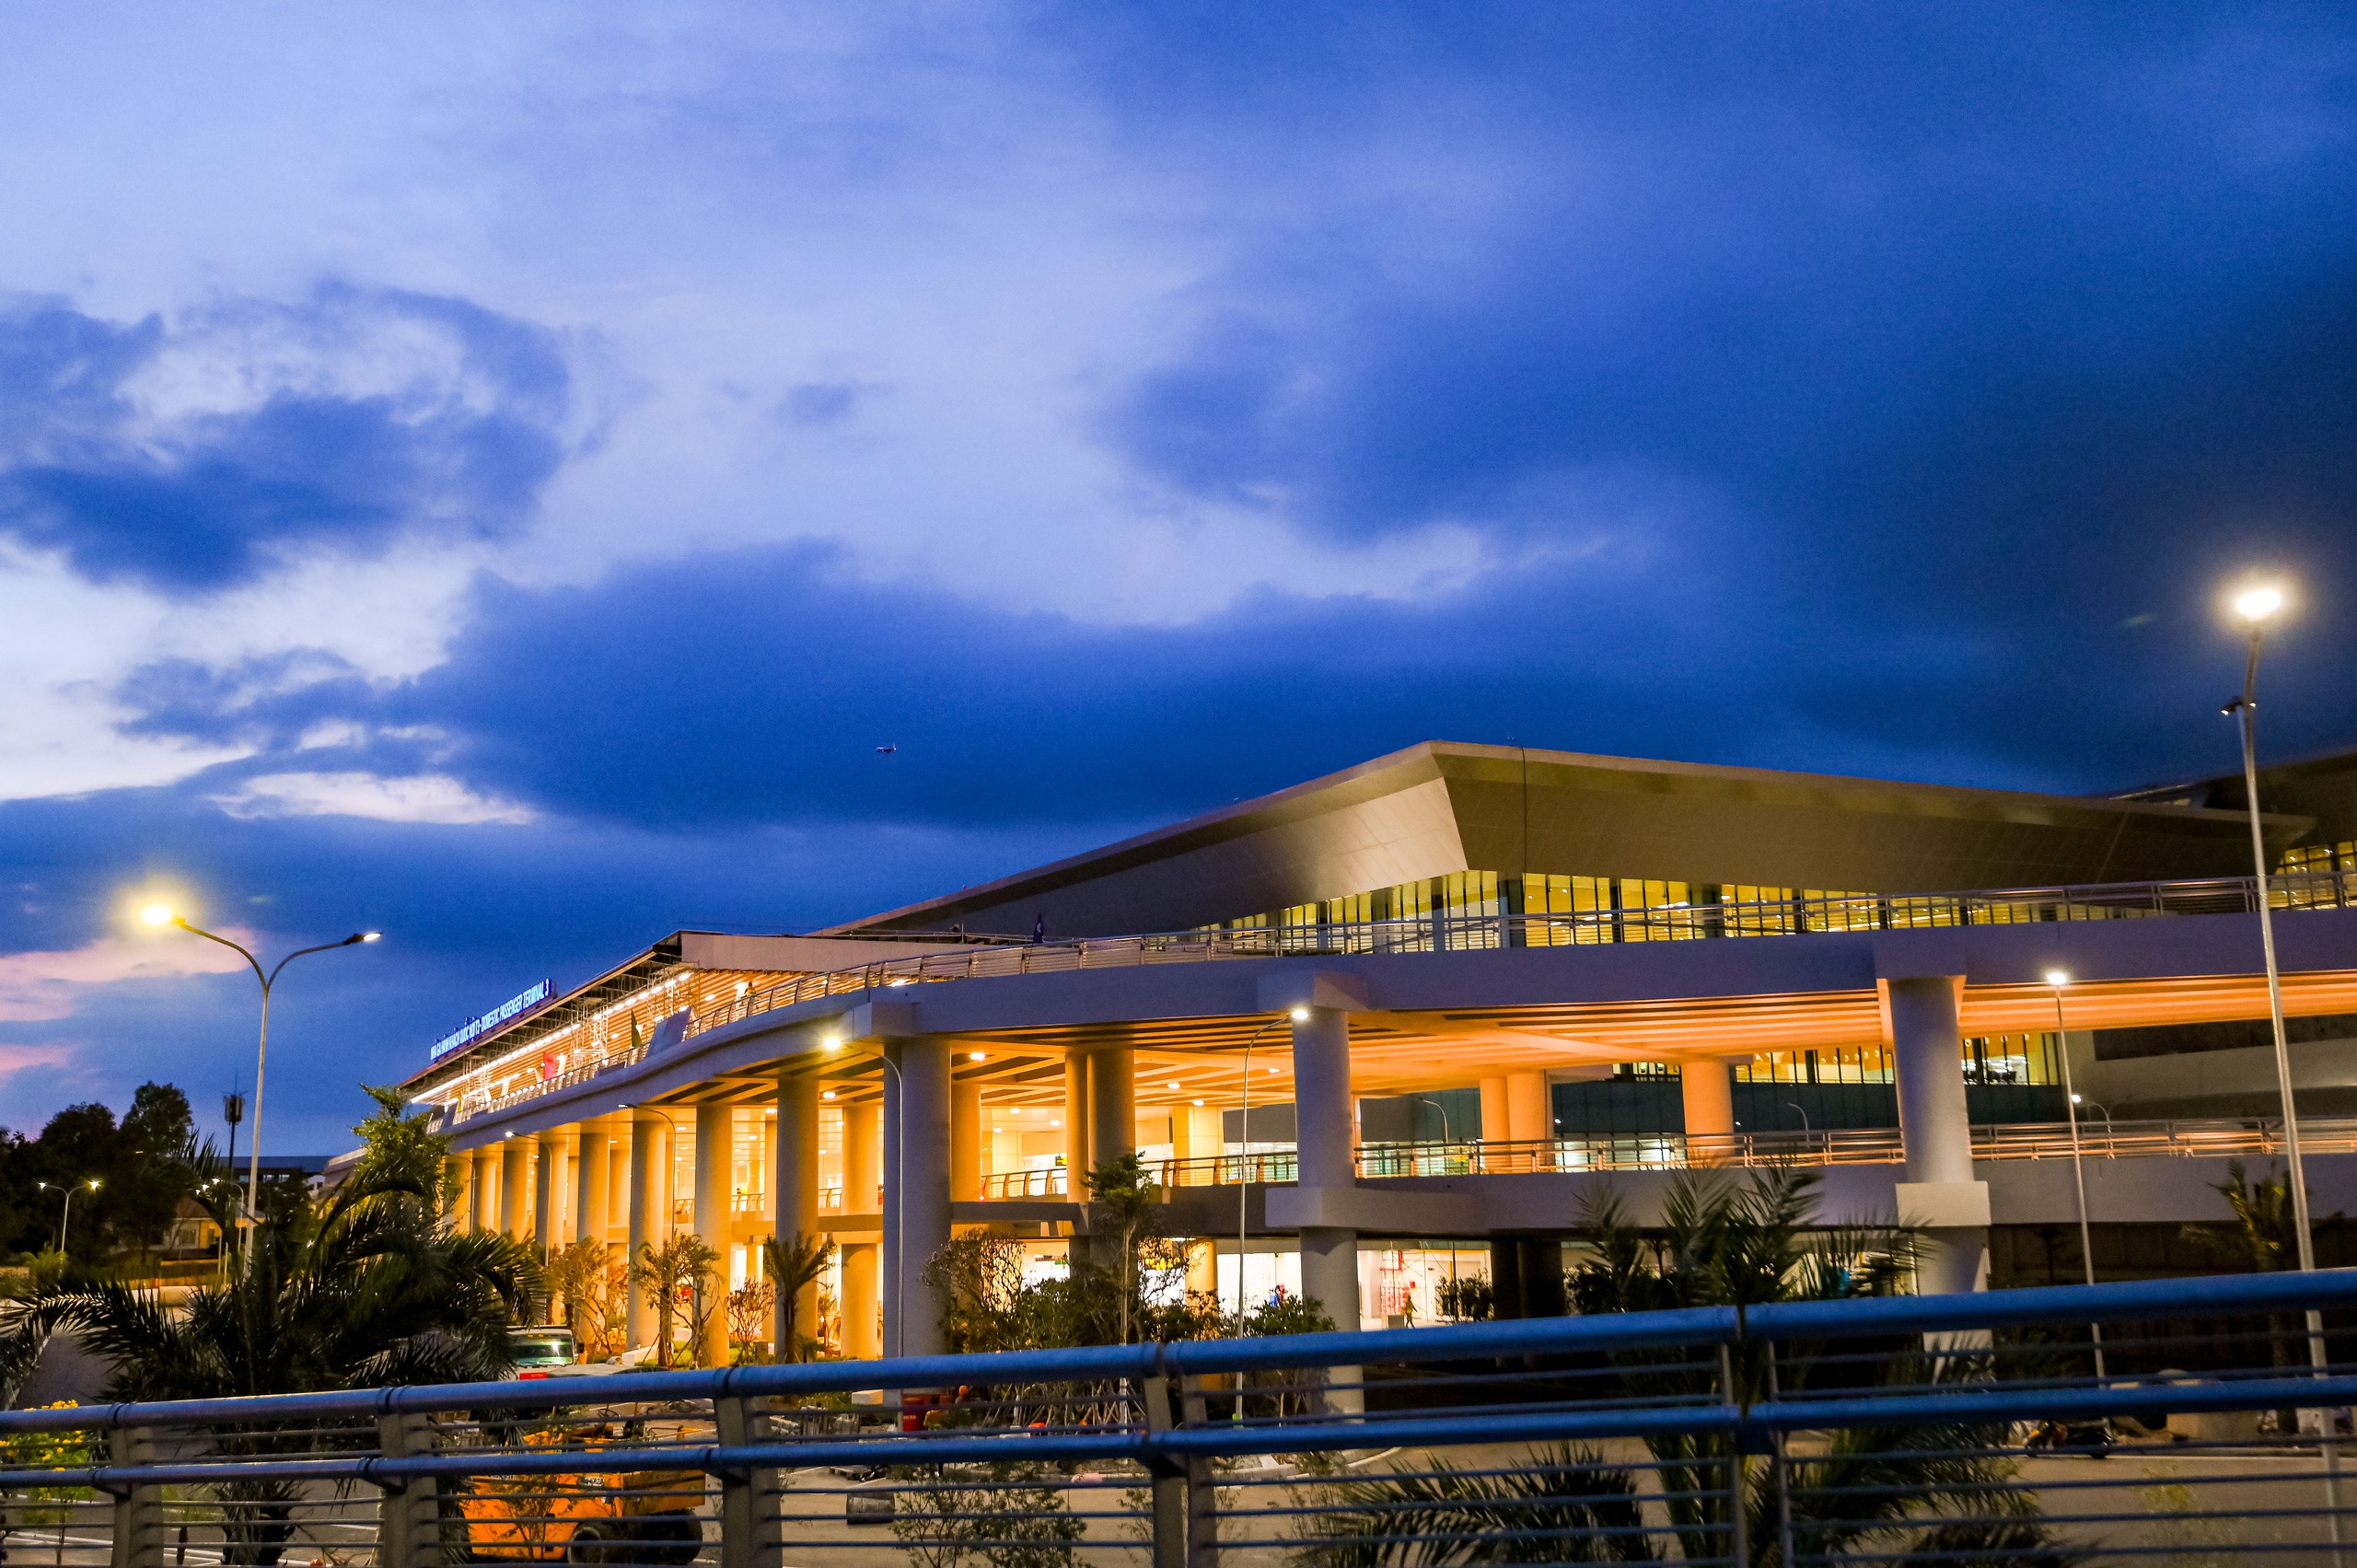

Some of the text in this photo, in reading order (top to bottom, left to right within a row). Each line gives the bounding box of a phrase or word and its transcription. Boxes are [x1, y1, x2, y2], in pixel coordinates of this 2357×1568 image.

[482, 1007, 499, 1032] DOMESTIC
[500, 994, 522, 1021] PASSENGER
[523, 981, 544, 1009] TERMINAL
[545, 978, 549, 997] 3
